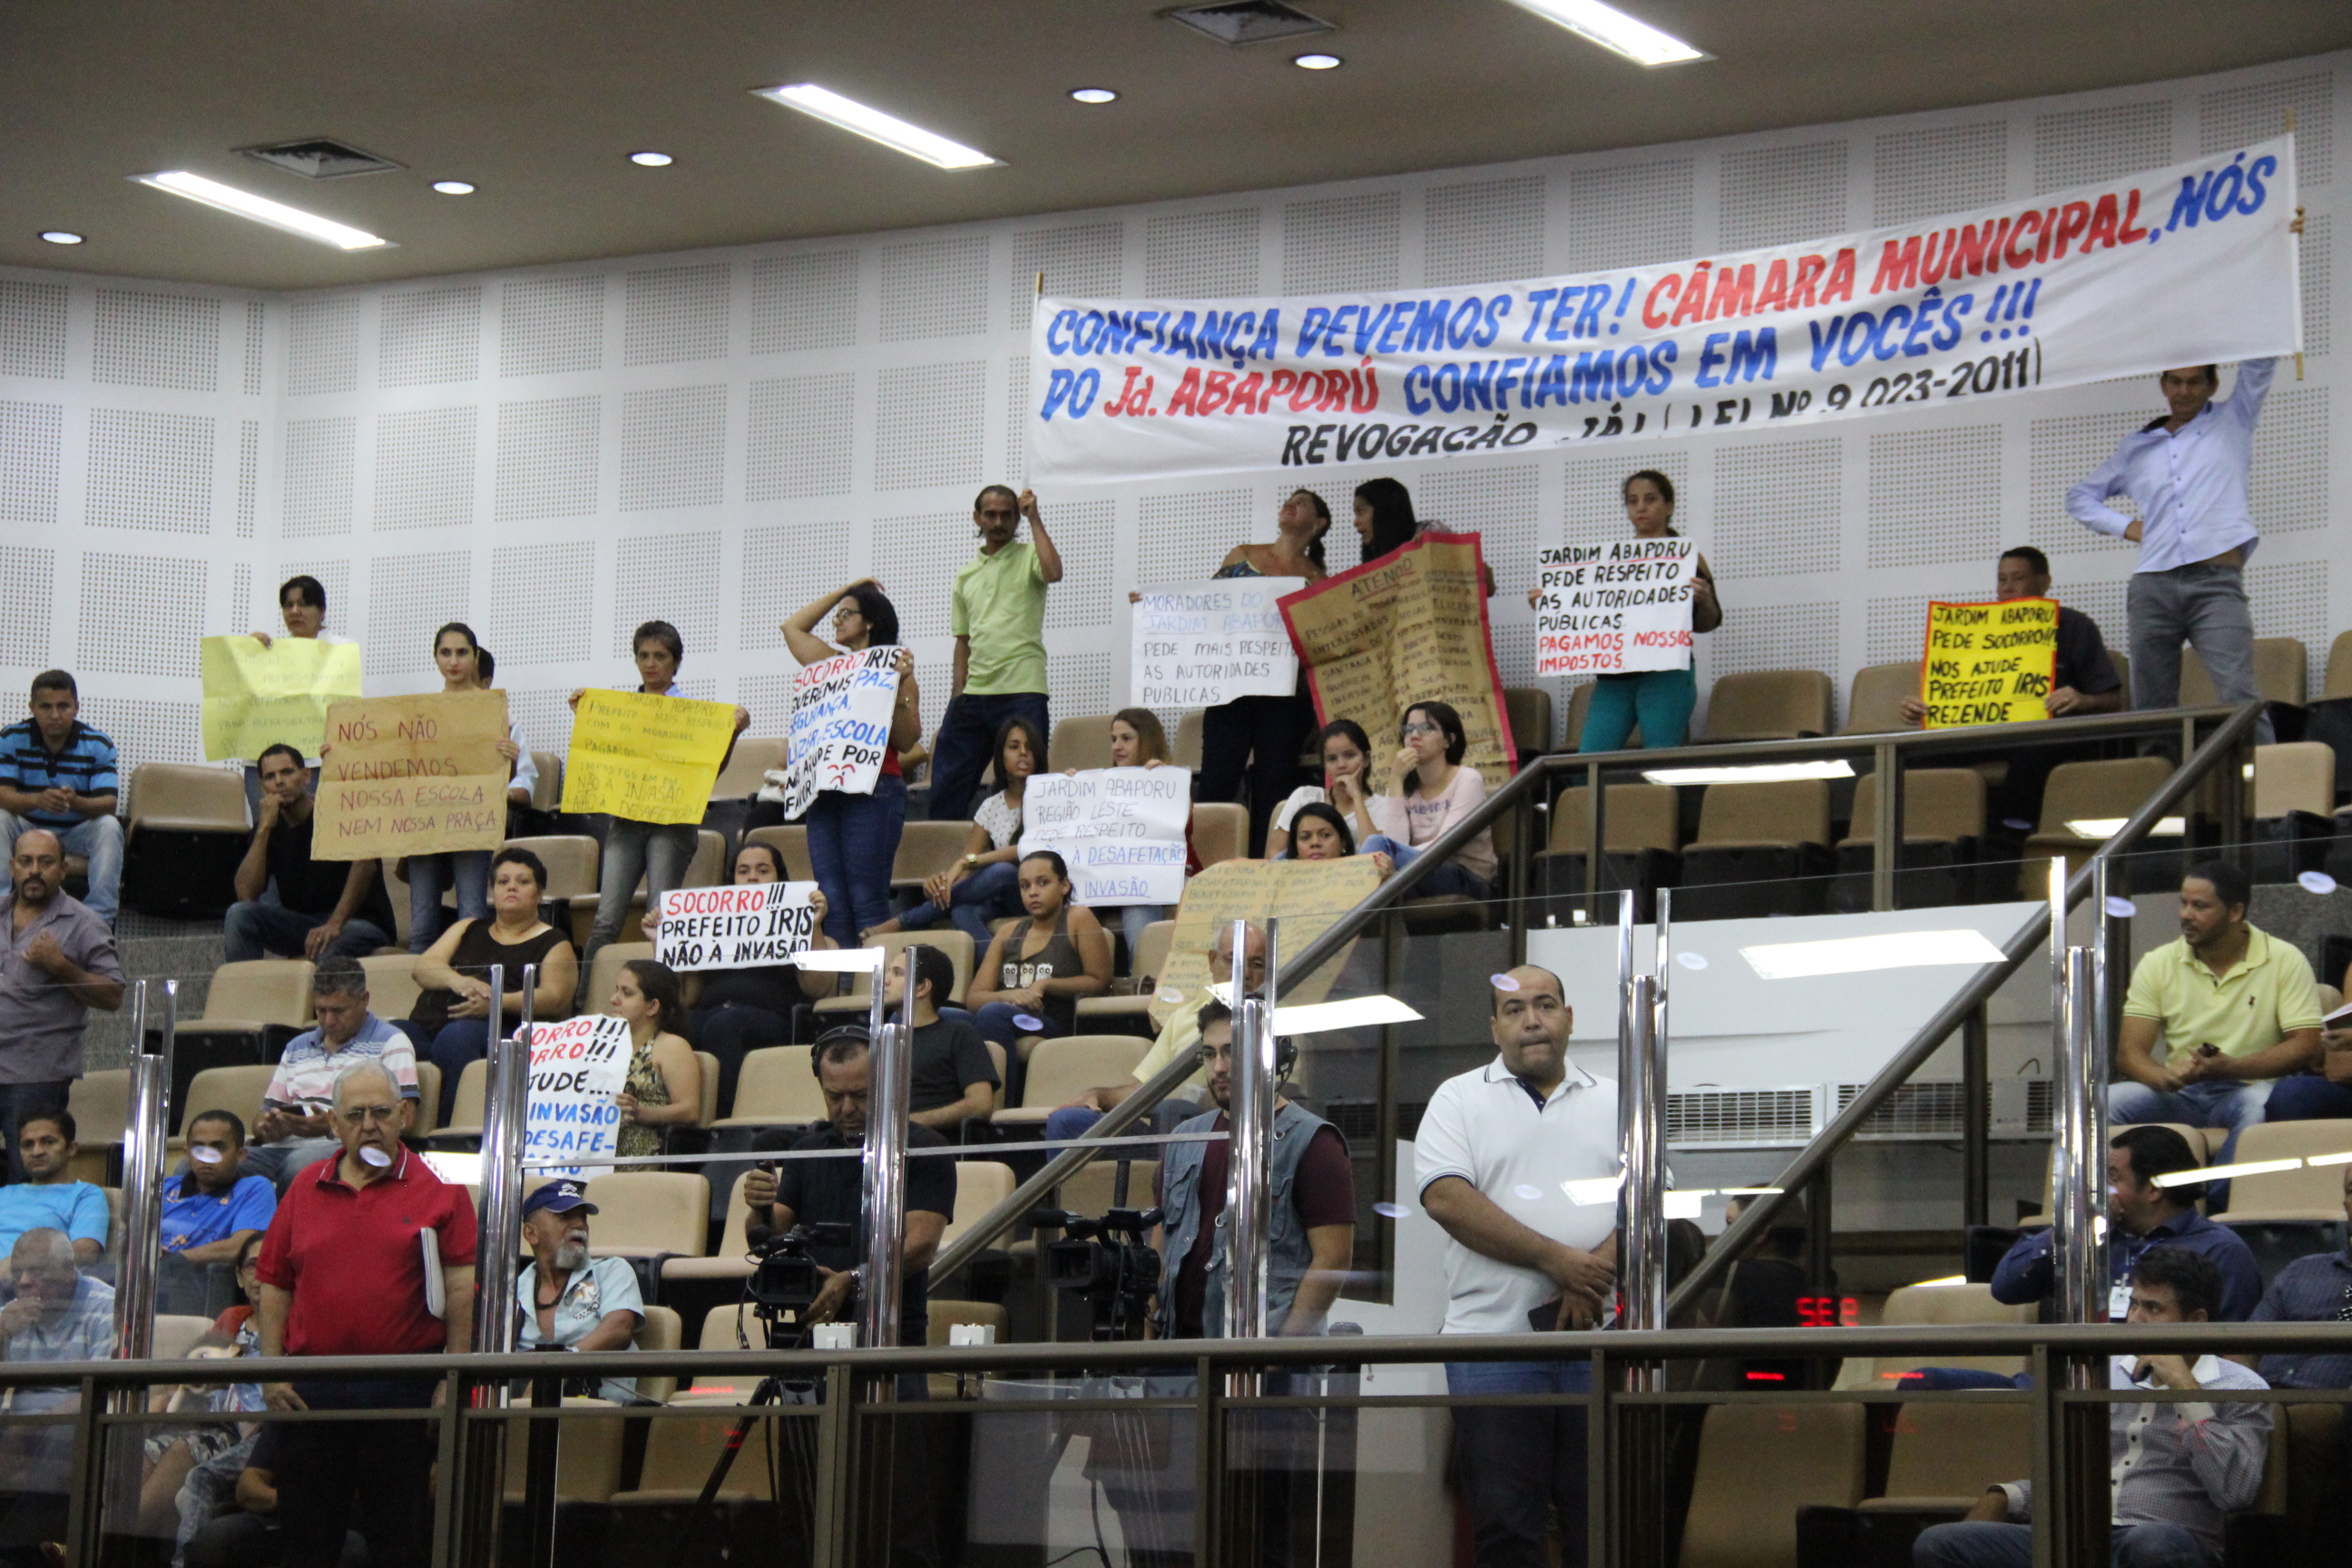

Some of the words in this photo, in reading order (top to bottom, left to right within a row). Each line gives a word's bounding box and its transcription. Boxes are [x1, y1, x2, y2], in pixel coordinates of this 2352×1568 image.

[1047, 309, 1279, 369] CONFIANÇA
[1295, 295, 1511, 358] DEVEMOS
[1523, 278, 1637, 344] TER!
[1642, 260, 1857, 329] CÂMARA
[2166, 152, 2277, 232] NÓS
[1040, 368, 1101, 421] DO
[1103, 366, 1158, 417] Jd.
[1165, 356, 1380, 417] ABAPORÚ
[1403, 341, 1679, 416] CONFIAMOS
[1695, 327, 1777, 388] EM
[1540, 546, 1602, 564] JARDIM
[1610, 541, 1691, 562] ABAPORU
[1542, 568, 1585, 588] PEDE
[1594, 563, 1680, 583] RESPEITO
[1143, 593, 1232, 612] MORADORES
[1240, 592, 1264, 607] DO
[1539, 593, 1562, 612] AS
[1572, 585, 1690, 609] AUTORIDADES
[1142, 615, 1207, 631] JARDIM
[1222, 612, 1285, 631] ABAPOR
[1933, 607, 1989, 626] JARDIM
[1144, 642, 1179, 657] PEDE
[1194, 642, 1232, 657] MAIS
[1540, 633, 1624, 653] PAGAMOS
[1633, 631, 1694, 647] NOSSOS
[1933, 630, 1975, 649] PEDE
[793, 652, 866, 692] SOCORRO
[864, 648, 900, 669] IRIS
[1144, 665, 1163, 680] AS
[1177, 662, 1270, 680] AUTORIDADES
[1971, 657, 2022, 677] AJUDE
[1928, 679, 2004, 701] PREFEITO
[2013, 672, 2052, 697] IRIS
[590, 701, 639, 718] PREFEITO
[627, 691, 664, 709] JARDIM
[1927, 702, 2013, 724] REZENDE
[338, 713, 377, 741] NÓS
[398, 713, 437, 740] NÃO
[822, 720, 887, 747] ESCOLA
[842, 744, 881, 766] POR
[338, 757, 458, 782] VENDEMOS
[340, 789, 405, 811] NOSSA
[415, 785, 485, 804] ESCOLA
[1034, 779, 1096, 799] JARDIM
[1105, 779, 1177, 799] ABAPORU
[339, 818, 382, 838] NEM
[391, 816, 436, 833] NOSSA
[446, 809, 496, 832] PRAÇA
[1035, 801, 1081, 824] REGIÃO
[1091, 802, 1138, 819] LESTE
[1075, 823, 1146, 838] RESPEITO
[1088, 844, 1186, 865] DESAFETAÇÃO
[1084, 877, 1149, 897] INVASÃO
[662, 916, 760, 940] PREFEITO
[765, 906, 815, 936] IRIS
[662, 940, 703, 967] NÃO
[529, 1100, 619, 1126] INVASÃO
